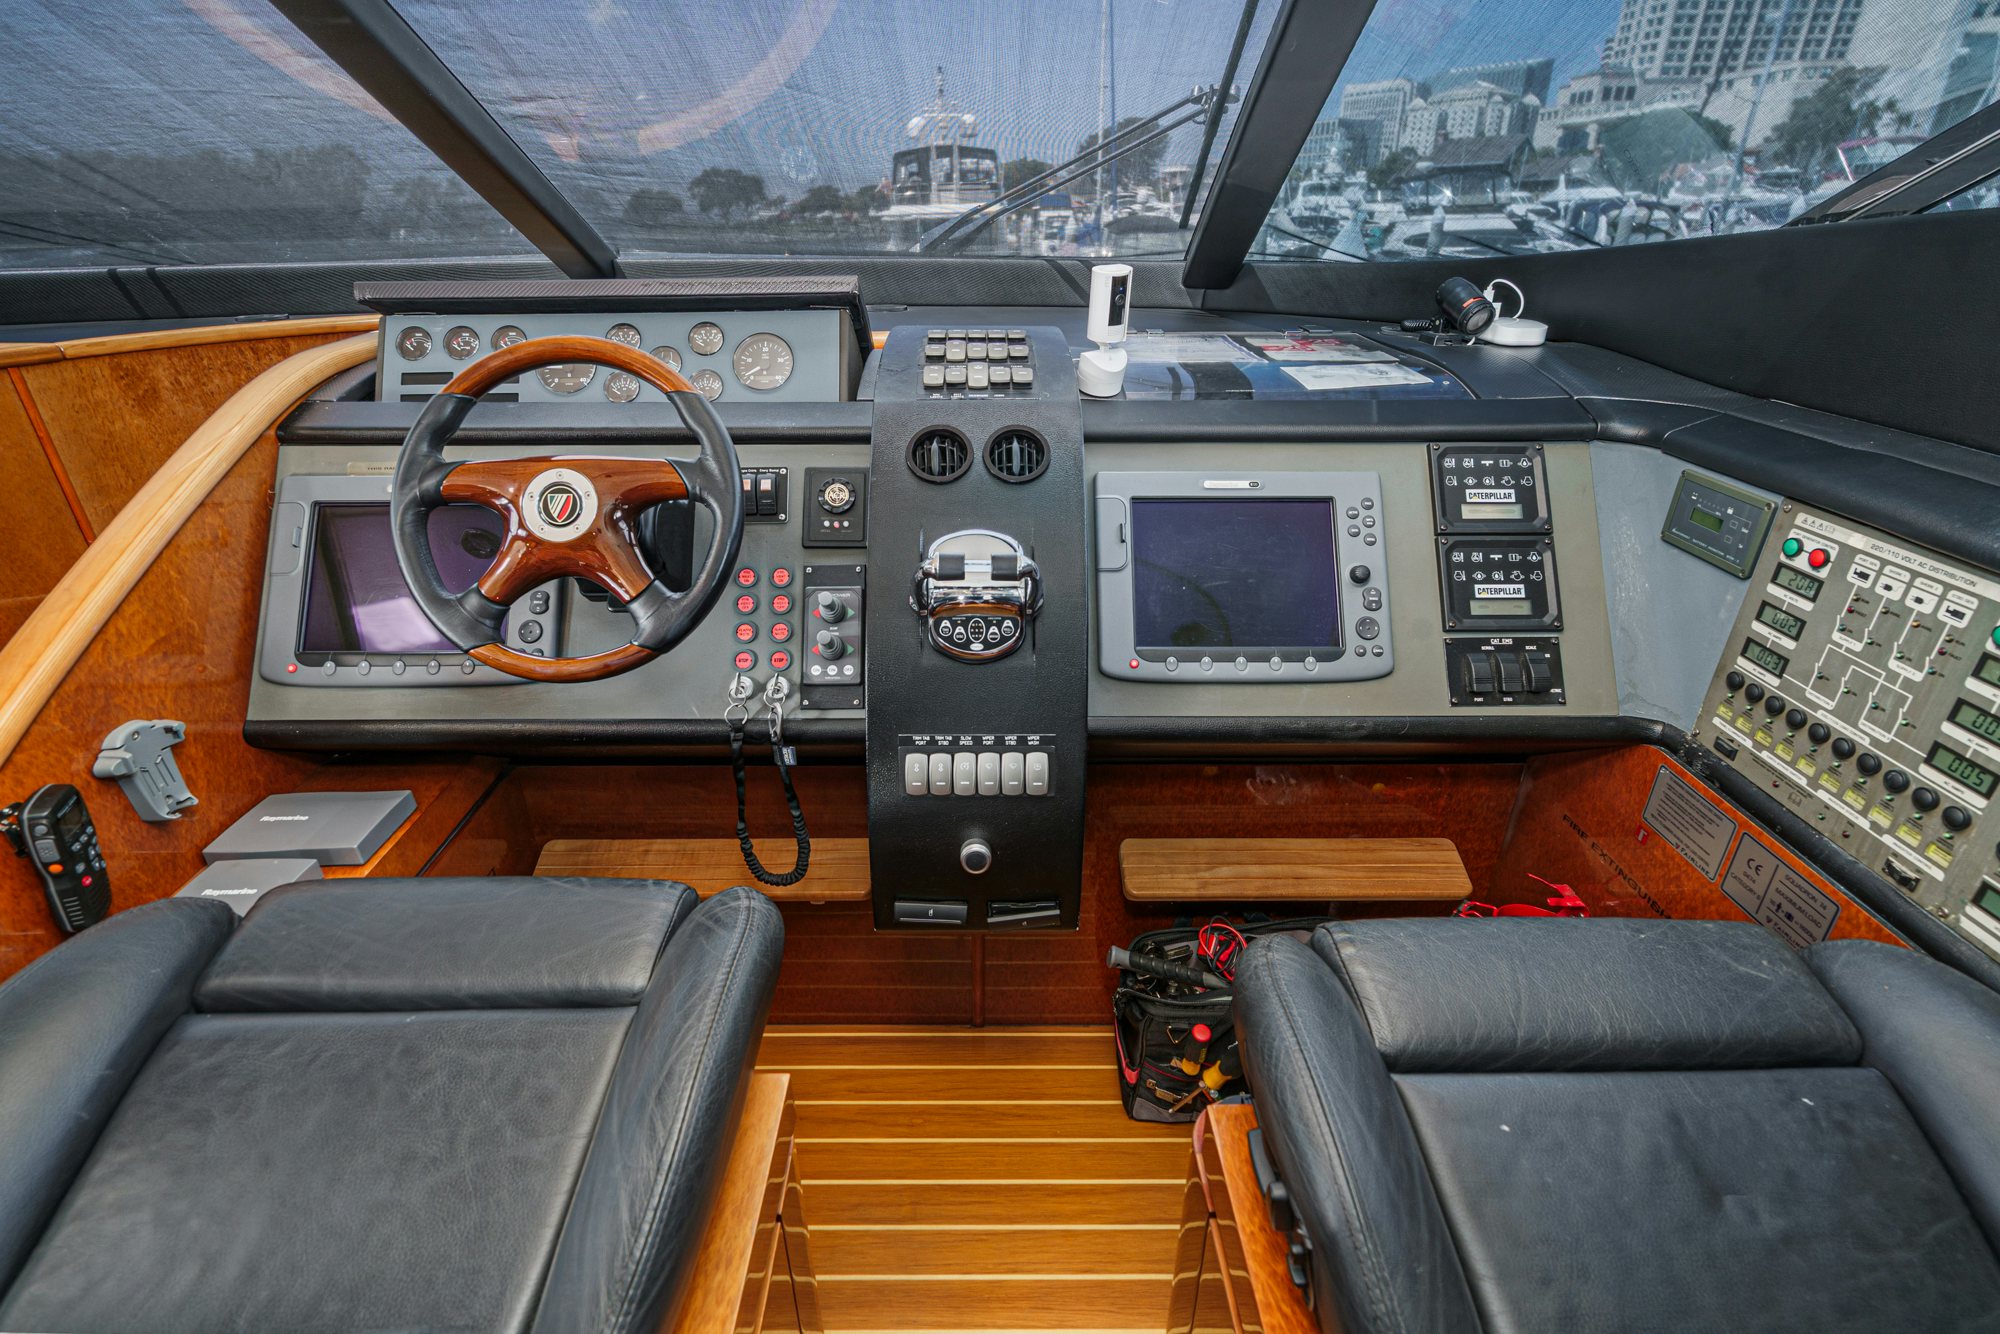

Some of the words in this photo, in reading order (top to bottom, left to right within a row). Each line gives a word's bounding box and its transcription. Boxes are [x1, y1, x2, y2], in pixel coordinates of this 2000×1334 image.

[1468, 492, 1513, 500] CATERPILLAR
[1870, 543, 1900, 558] 220/110
[1901, 554, 1917, 565] VOLT
[1917, 560, 1928, 569] AC
[1928, 565, 1978, 588] DISTRIBUTION
[1477, 587, 1522, 596] CATERPILLAR
[1948, 757, 1987, 787] 005
[1562, 814, 1588, 841] FIRE
[1680, 848, 1710, 876] FAIRLINE
[201, 888, 258, 896] Raymarine
[1785, 874, 1818, 903] SQUADRON
[1806, 912, 1822, 928] LOAD
